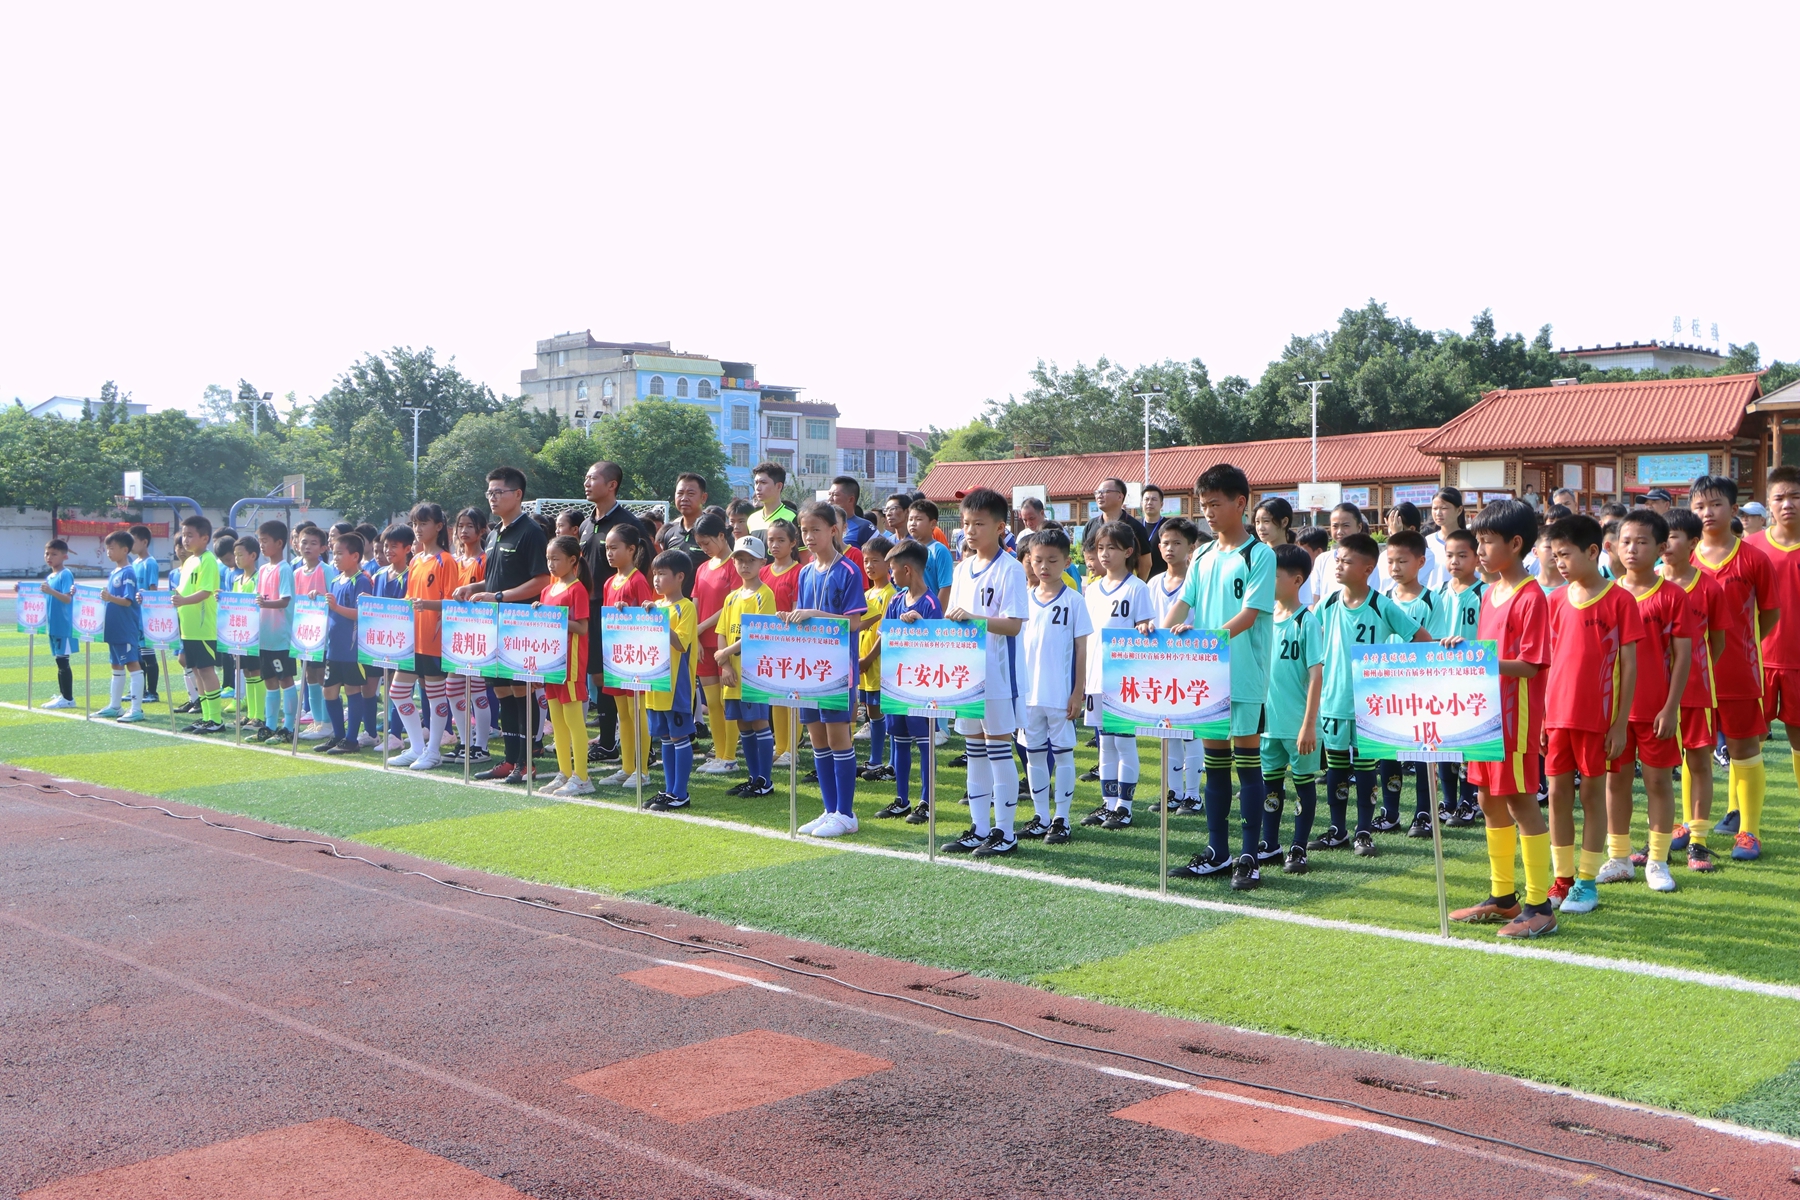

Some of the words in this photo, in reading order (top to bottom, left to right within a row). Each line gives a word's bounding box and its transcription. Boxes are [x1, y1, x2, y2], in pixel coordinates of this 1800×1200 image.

[190, 572, 198, 584] 11
[427, 573, 435, 588] 9
[1233, 578, 1244, 599] 8
[980, 587, 995, 607] 17
[1052, 605, 1069, 626] 21
[1110, 599, 1130, 618] 20
[1462, 606, 1476, 626] 18
[366, 628, 405, 649] 南亚小学
[452, 632, 487, 657] 裁判员
[1355, 623, 1376, 645] 21
[503, 636, 561, 655] 穿山中心小学
[612, 644, 660, 667] 思荣小学
[1280, 639, 1300, 660] 20
[273, 658, 283, 673] 9
[523, 656, 538, 671] 2队
[1110, 652, 1218, 662] 柳州市柳江区首届乡村小学生足球比赛
[756, 655, 832, 682] 高平小学
[896, 662, 970, 689] 仁安小学
[1363, 667, 1486, 678] 柳州市柳江区首届乡村小学生足球比赛
[1119, 676, 1210, 707] 林寺小学
[1365, 692, 1488, 717] 穿山中心小学
[1322, 717, 1338, 736] 21
[1412, 721, 1443, 745] 1队
